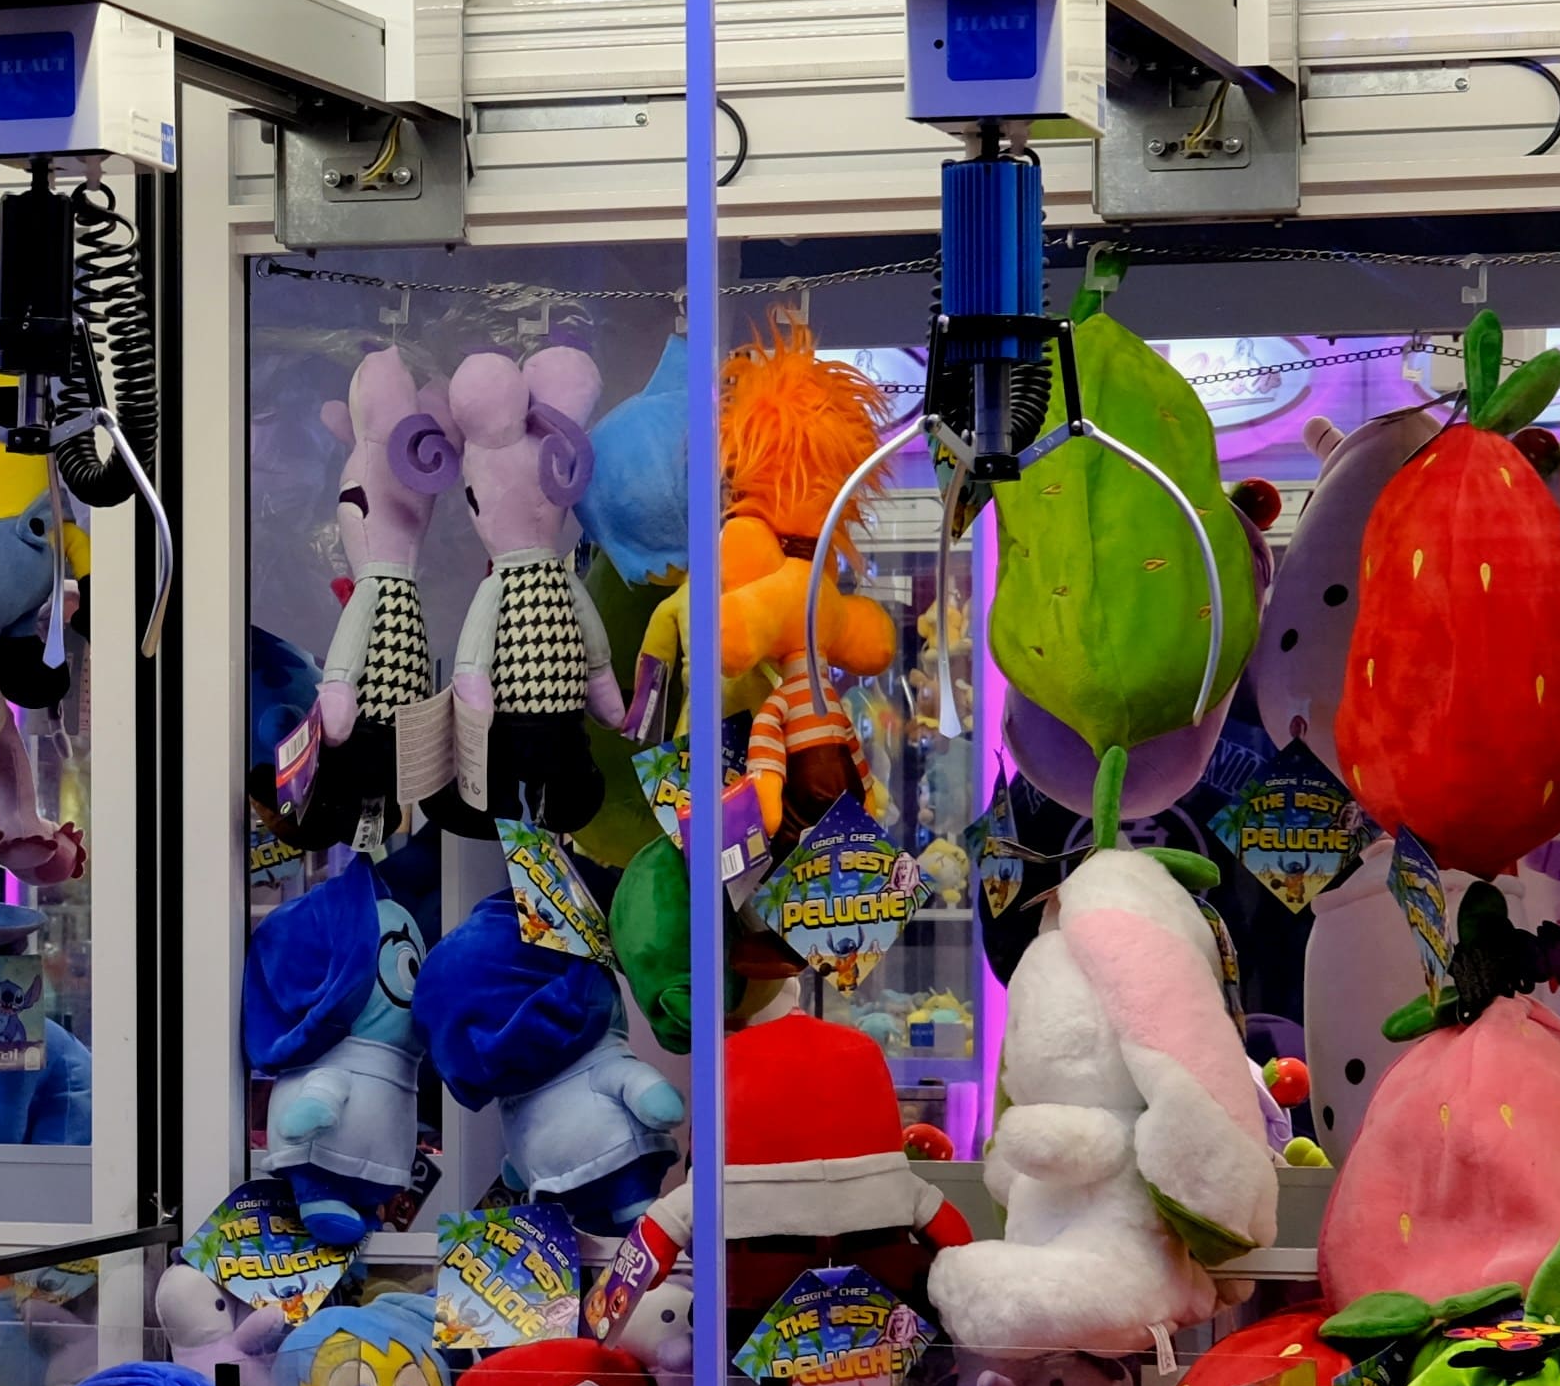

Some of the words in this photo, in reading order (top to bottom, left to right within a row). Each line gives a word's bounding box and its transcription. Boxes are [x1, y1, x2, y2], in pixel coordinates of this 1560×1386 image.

[1251, 792, 1285, 813] THE
[1294, 793, 1342, 814] BEST
[849, 833, 877, 844] CHEZ
[1242, 827, 1350, 851] PELUCHE
[792, 855, 832, 884] THE
[839, 851, 897, 876] BEST
[512, 845, 603, 956] PELUCHE
[783, 890, 906, 930] PELUCHE
[219, 1216, 262, 1240] THE
[217, 1246, 347, 1280] PELUCHE
[485, 1221, 525, 1255] THE
[523, 1250, 568, 1300] BEST
[627, 1251, 646, 1288] 2
[446, 1243, 547, 1338] PELUCHE
[839, 1287, 869, 1297] CHEZ
[776, 1309, 821, 1340] THE
[829, 1304, 890, 1328] BEST
[772, 1342, 904, 1384] PELUCHE
